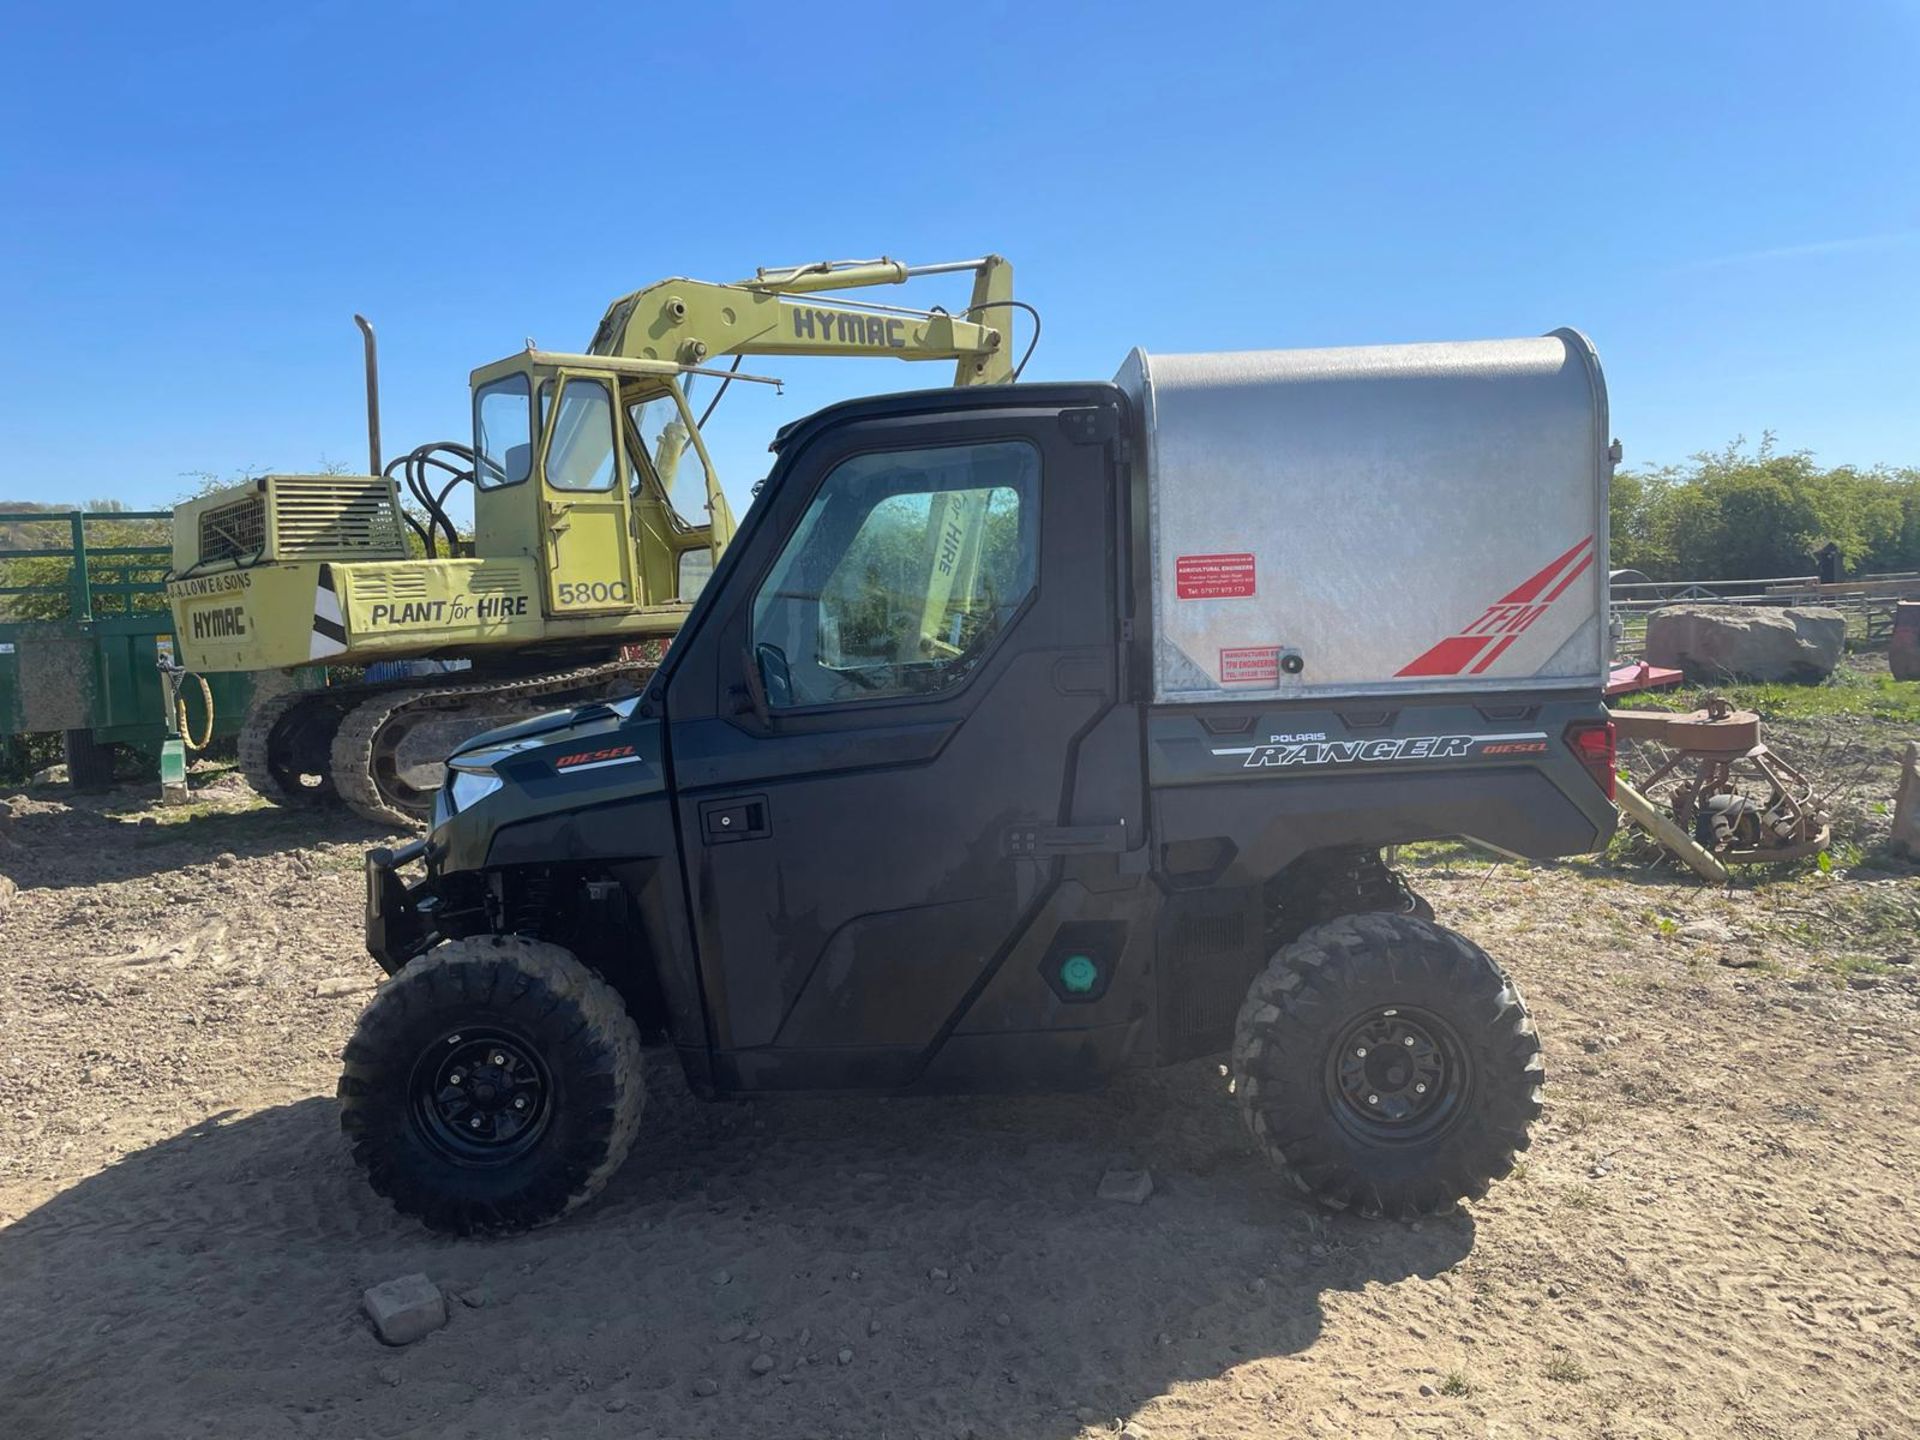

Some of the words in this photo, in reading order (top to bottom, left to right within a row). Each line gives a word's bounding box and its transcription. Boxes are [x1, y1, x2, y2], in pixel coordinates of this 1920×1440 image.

[793, 308, 906, 348] HYMAC
[939, 522, 962, 577] HIRE
[185, 578, 216, 596] LOWE
[223, 572, 252, 590] SONS
[558, 581, 628, 605] 580C
[193, 606, 246, 639] HYMAC
[372, 601, 447, 625] PLANT
[446, 594, 473, 625] for
[477, 596, 529, 618] HIRE
[1460, 604, 1550, 635] TFM
[1243, 735, 1474, 767] RANGER
[1482, 742, 1547, 755] DIESEL
[1270, 732, 1326, 743] POLARIS
[556, 745, 635, 767] DIESEL
